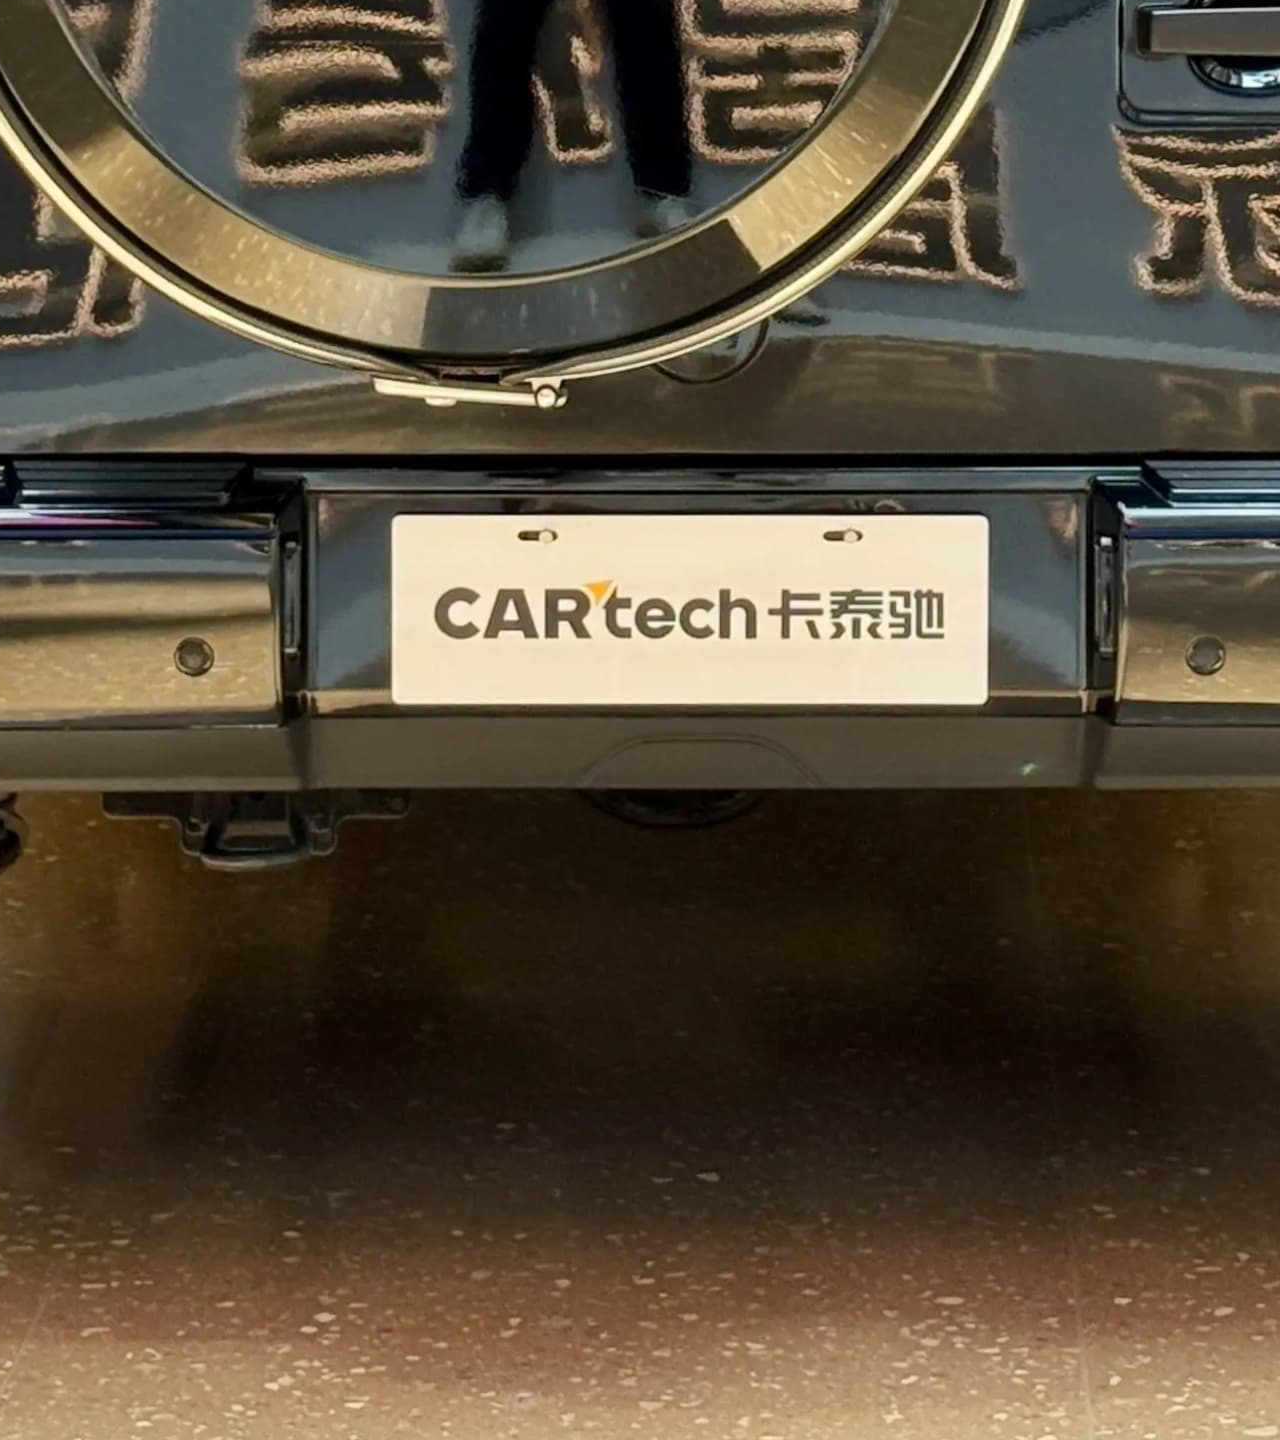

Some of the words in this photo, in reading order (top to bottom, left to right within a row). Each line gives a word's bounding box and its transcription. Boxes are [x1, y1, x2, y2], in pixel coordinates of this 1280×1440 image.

[433, 583, 757, 640] CARtech
[767, 588, 946, 640] 卡泰驰
